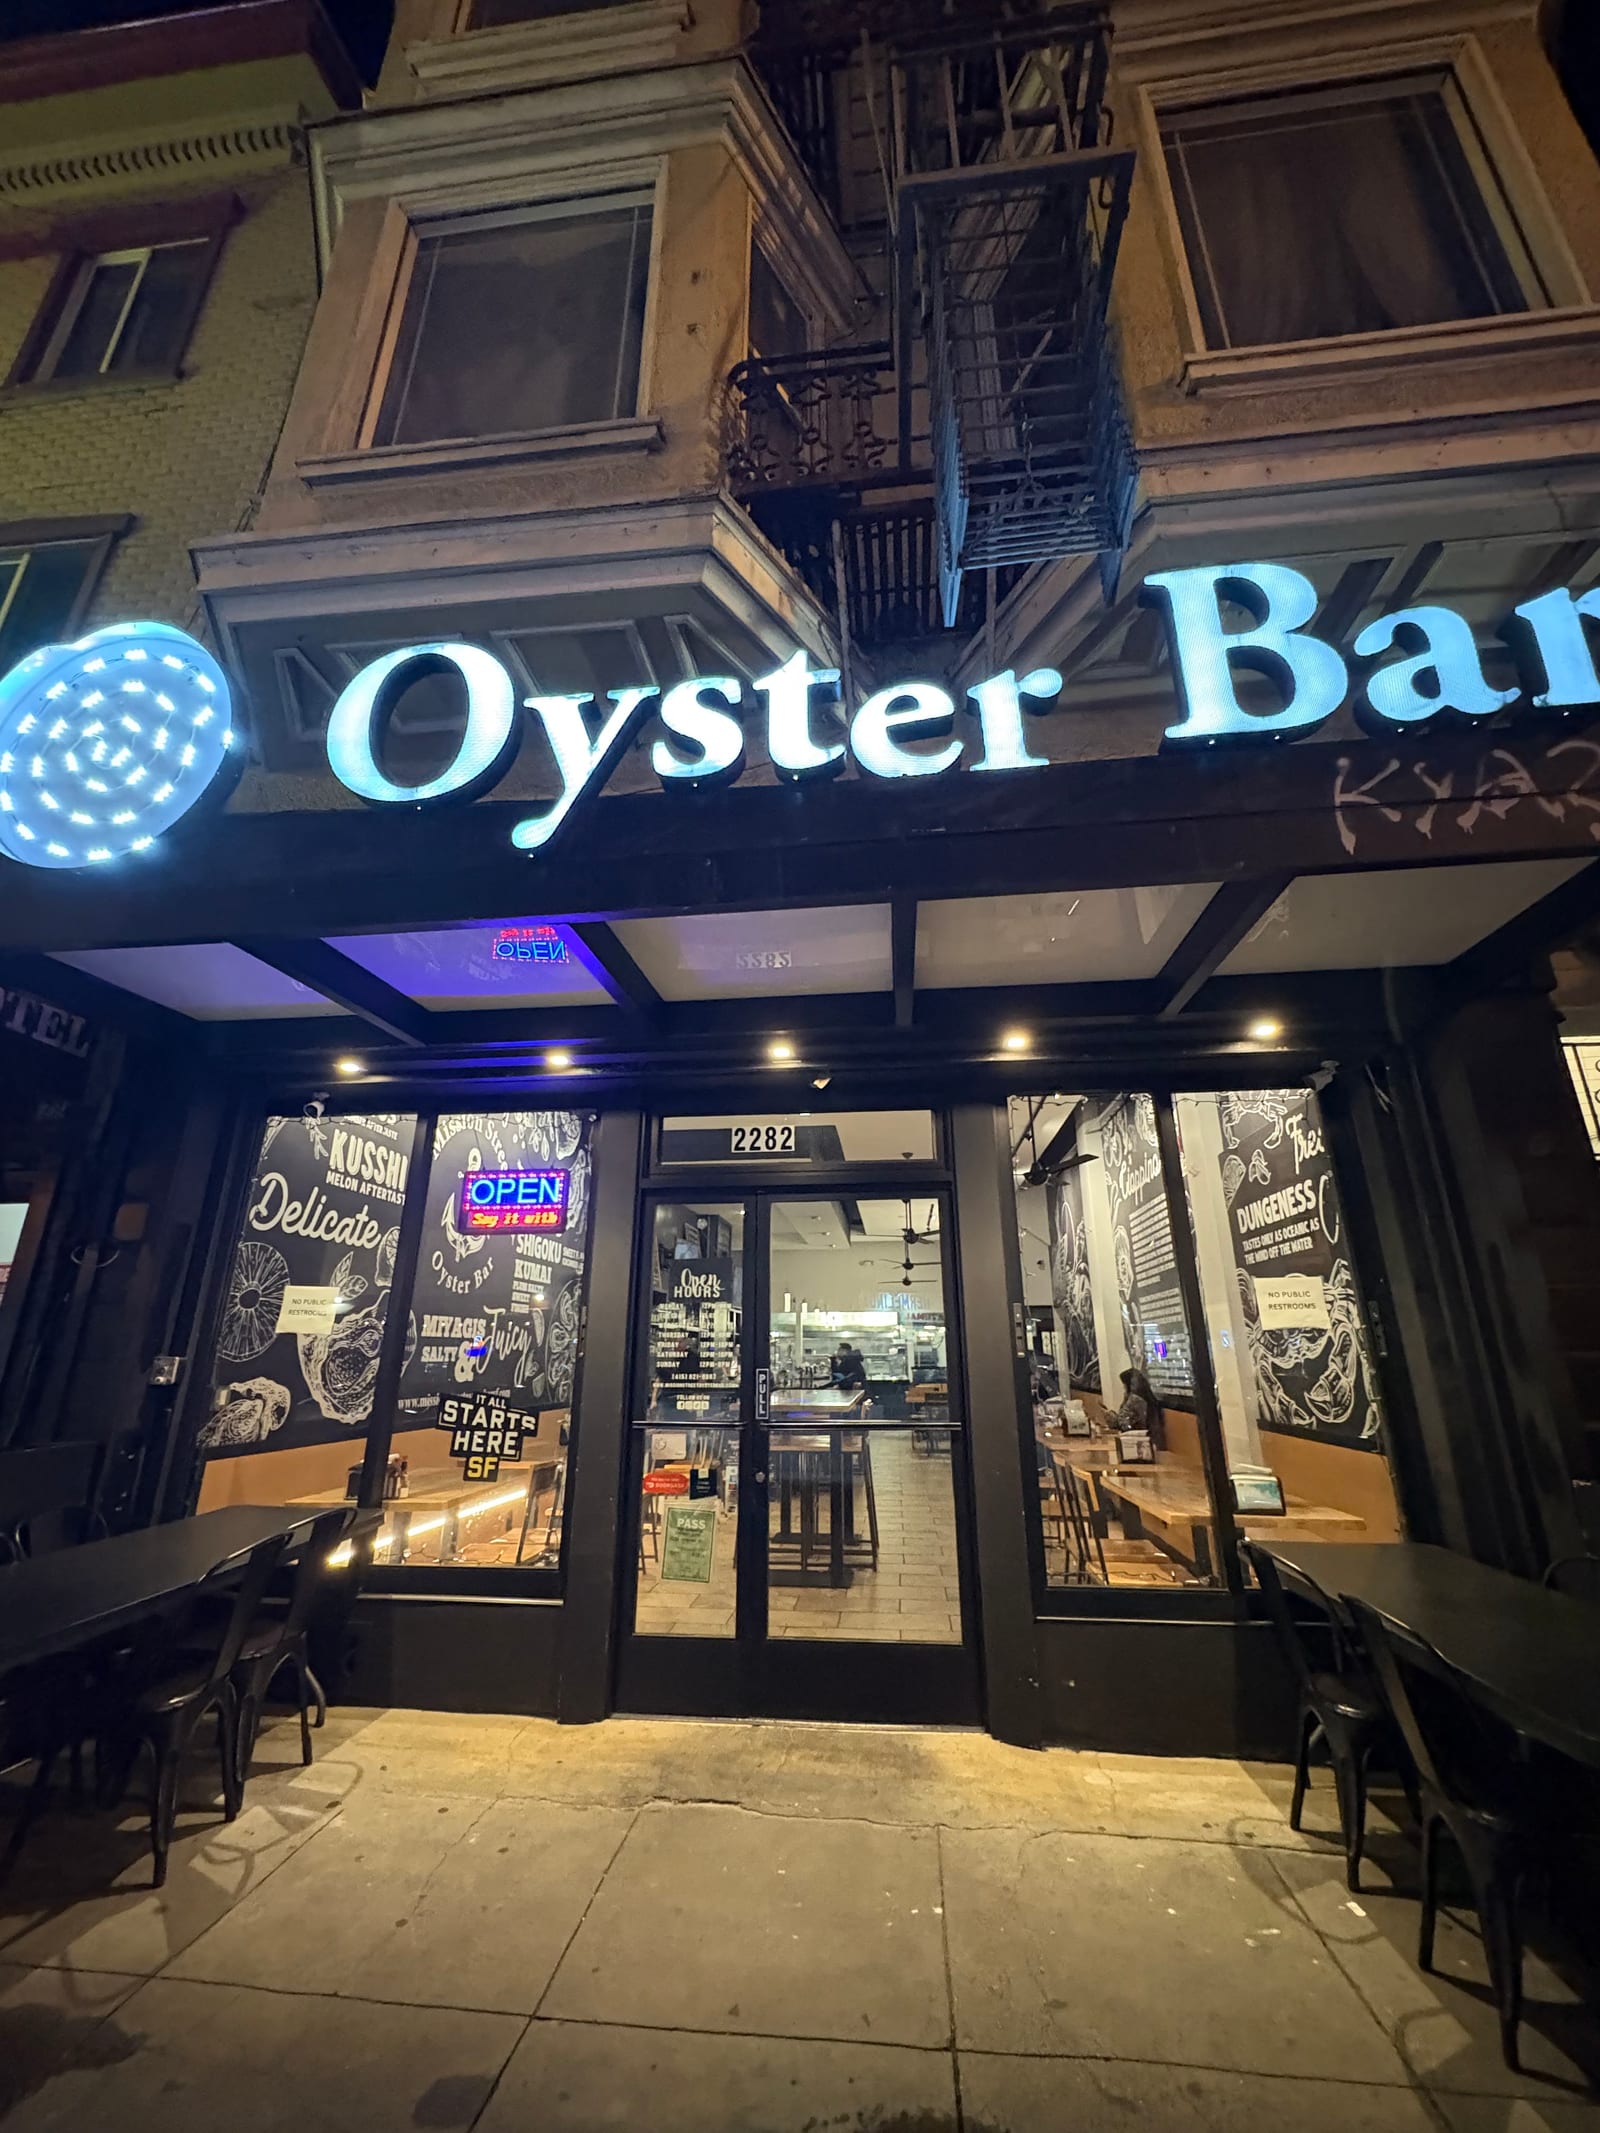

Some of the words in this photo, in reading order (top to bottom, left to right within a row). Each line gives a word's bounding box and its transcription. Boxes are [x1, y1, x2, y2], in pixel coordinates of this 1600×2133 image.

[326, 641, 1064, 851] Oyster
[1144, 563, 1600, 739] Bar
[432, 1114, 483, 1161] Mission
[484, 1119, 510, 1170] Stree
[733, 1126, 793, 1151] 2282
[328, 1128, 409, 1192] KUSSHI
[325, 1170, 359, 1192] MELON
[359, 1181, 406, 1206] AFTERTAST
[471, 1177, 560, 1205] OPEN
[248, 1171, 382, 1249] Delicate
[1236, 1178, 1317, 1235] DUNGENESS
[1242, 1236, 1262, 1252] TASTES
[1282, 1220, 1310, 1240] OCEANIC
[1309, 1217, 1320, 1232] AS
[1290, 1235, 1314, 1254] WATER
[516, 1234, 563, 1264] SHIGOKU
[432, 1250, 472, 1295] Oyster
[473, 1256, 494, 1289] Bar
[513, 1258, 553, 1285] KUMAI
[681, 1268, 725, 1295] Open
[303, 1298, 327, 1306] PUBLIC
[673, 1286, 721, 1298] HOURS
[1281, 1290, 1311, 1298] PUBLIC
[1268, 1302, 1317, 1311] RESTROOMS
[421, 1314, 488, 1338] MIYAGIS
[420, 1346, 459, 1363] SALTY
[475, 1305, 533, 1388] Juicy
[476, 1394, 487, 1405] IT
[487, 1396, 507, 1410] ALL
[758, 1374, 766, 1414] PULL
[442, 1399, 537, 1431] STARTS
[453, 1430, 519, 1456] HERE
[467, 1455, 498, 1479] SF
[676, 1518, 706, 1530] PASS
